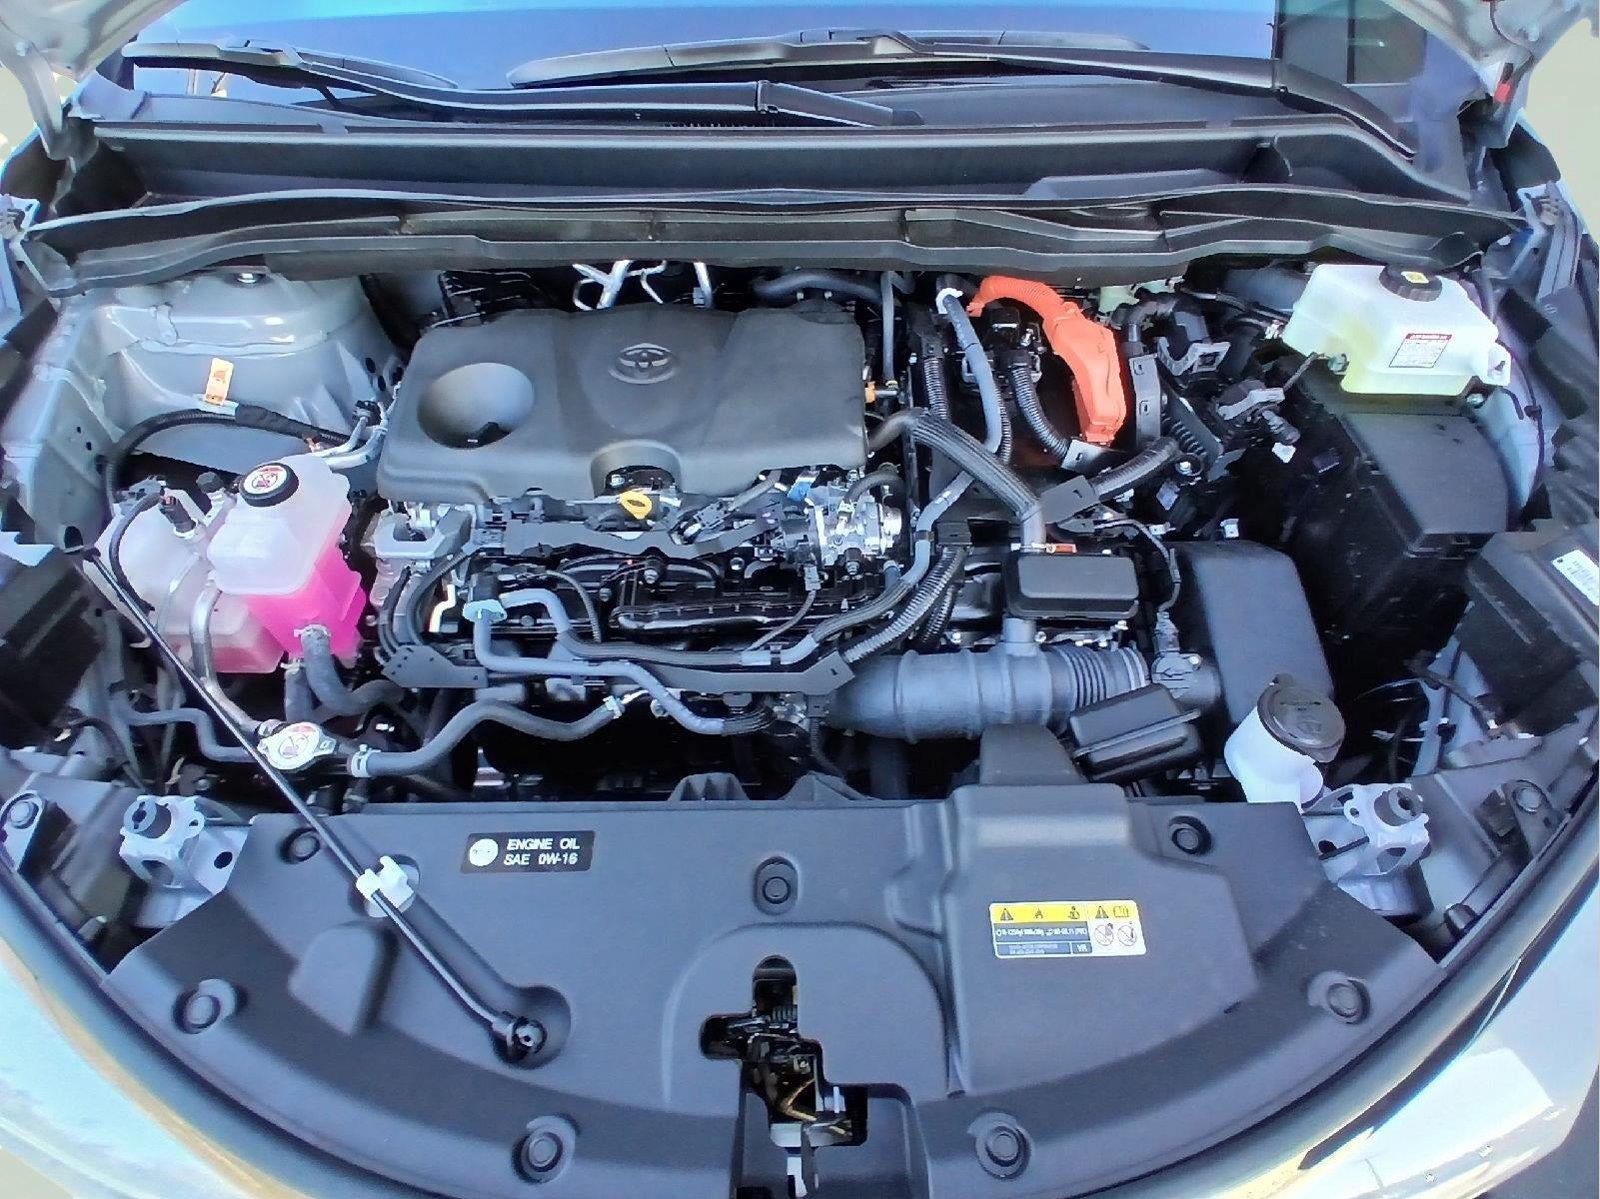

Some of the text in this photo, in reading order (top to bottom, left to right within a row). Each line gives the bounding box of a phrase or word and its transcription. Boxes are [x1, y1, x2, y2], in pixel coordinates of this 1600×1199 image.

[506, 837, 581, 850] ENGINE OIL
[503, 852, 578, 866] SAE 0W-16
